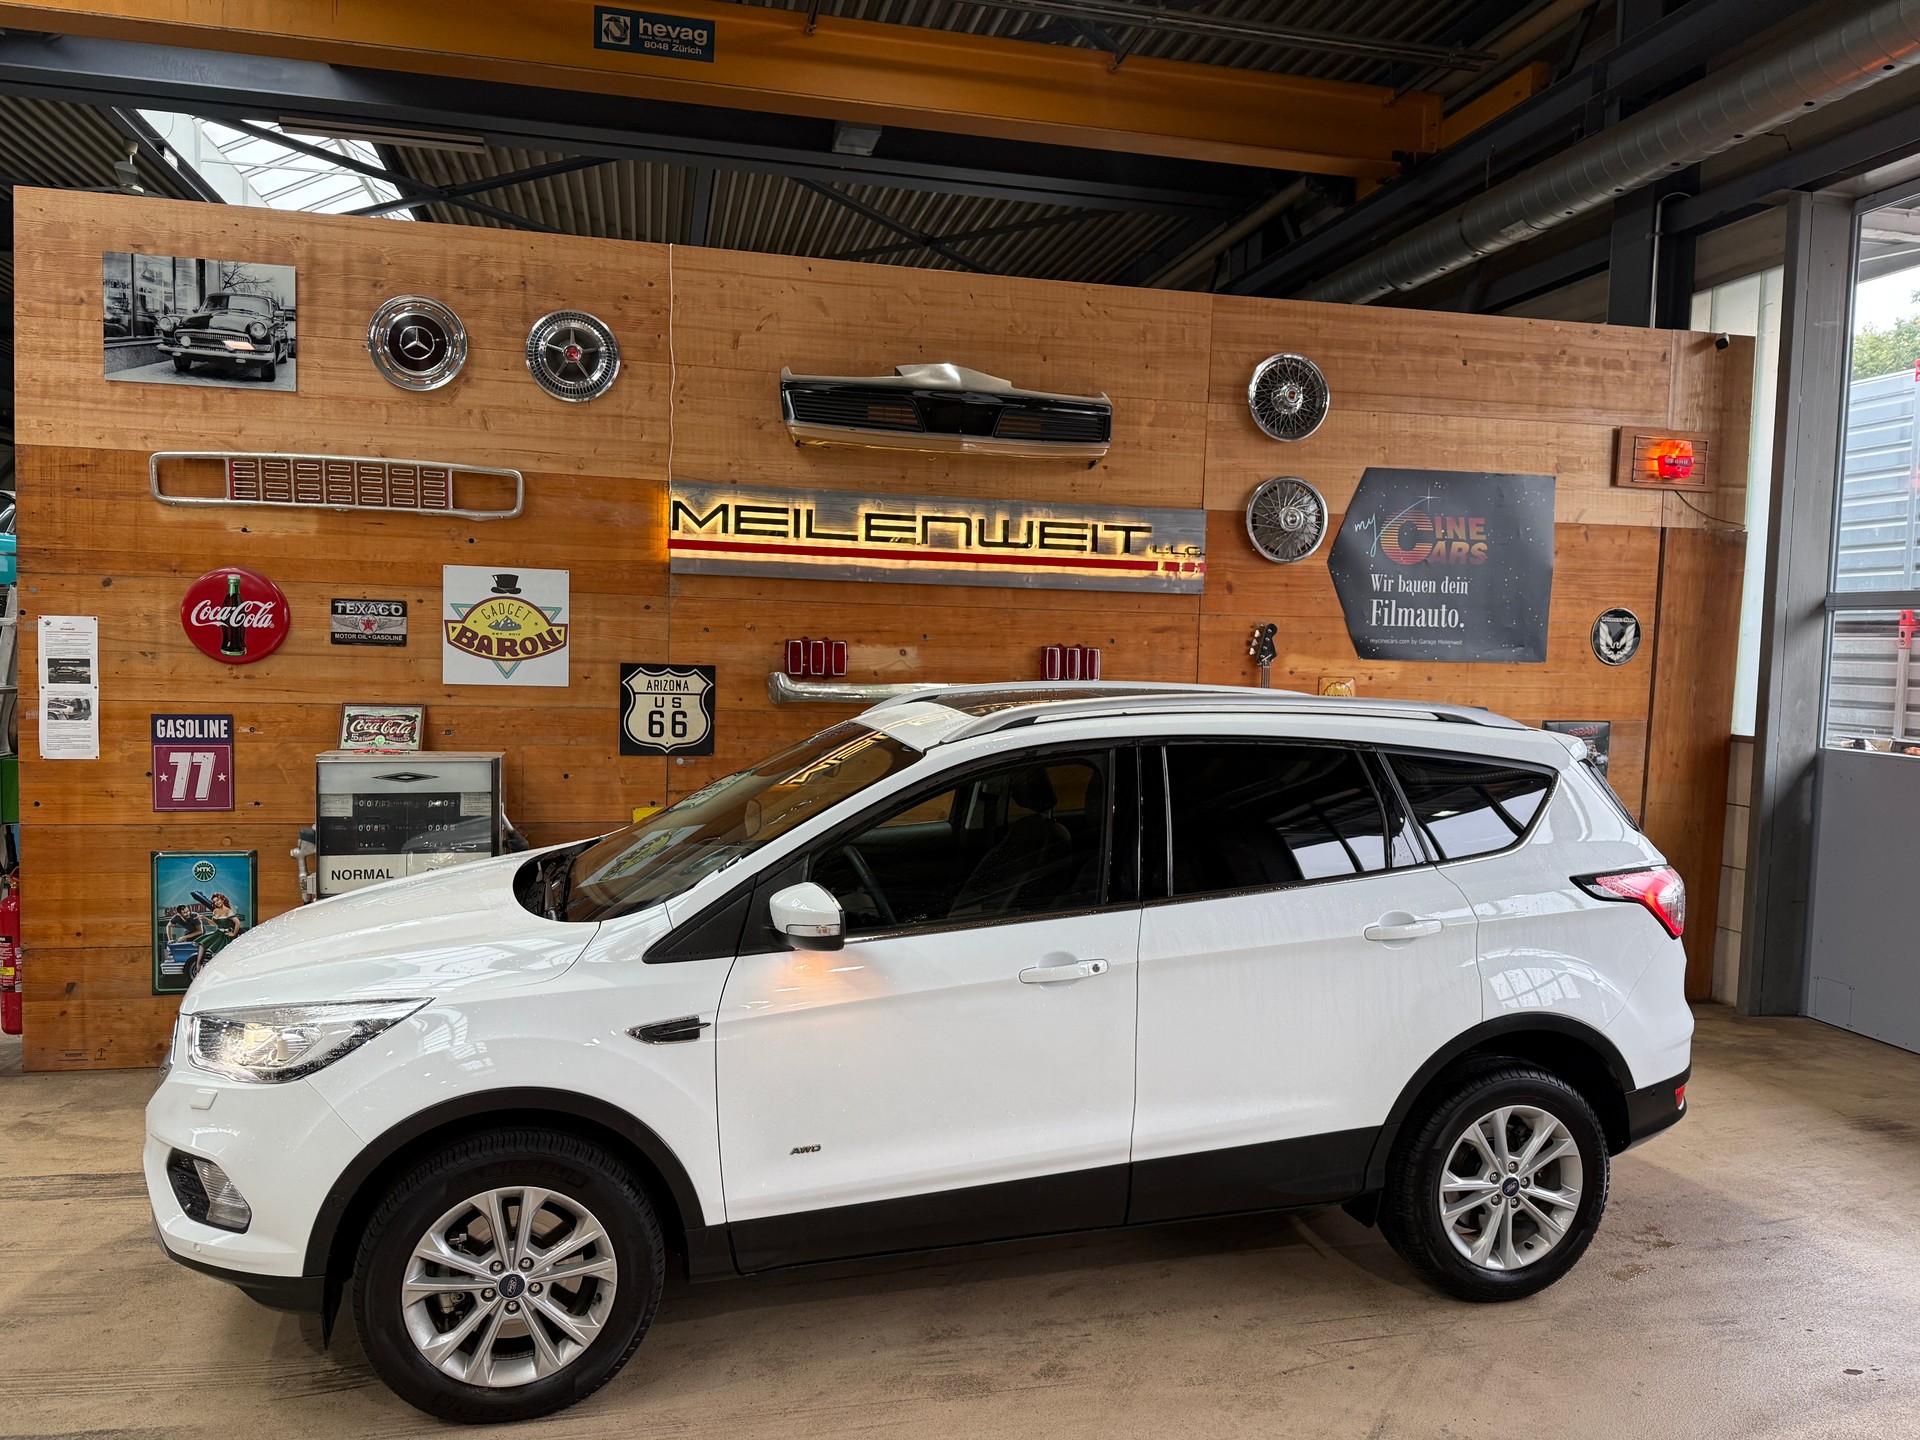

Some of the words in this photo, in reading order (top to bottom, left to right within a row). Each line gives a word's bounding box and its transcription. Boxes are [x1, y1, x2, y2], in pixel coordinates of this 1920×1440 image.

[639, 18, 708, 47] hevag
[644, 40, 669, 51] 8048
[672, 44, 702, 55] Zürich
[672, 500, 1152, 553] MEILENWEIT
[1354, 513, 1380, 558] my
[1370, 574, 1394, 592] Wir
[1398, 575, 1436, 594] bauen
[1441, 579, 1469, 595] dein
[191, 600, 276, 628] Coca-Cola
[334, 602, 404, 616] TEXACO
[481, 602, 532, 621] GADGET
[1369, 599, 1465, 628] Filmauto.
[452, 625, 562, 657] BARON
[647, 679, 691, 692] ARIZONA
[157, 719, 228, 738] GASOLINE
[350, 719, 415, 734] Coca-Cola
[648, 710, 688, 738] 66
[169, 752, 216, 801] 77
[331, 868, 394, 881] NORMAL
[790, 1144, 821, 1155] AWD
